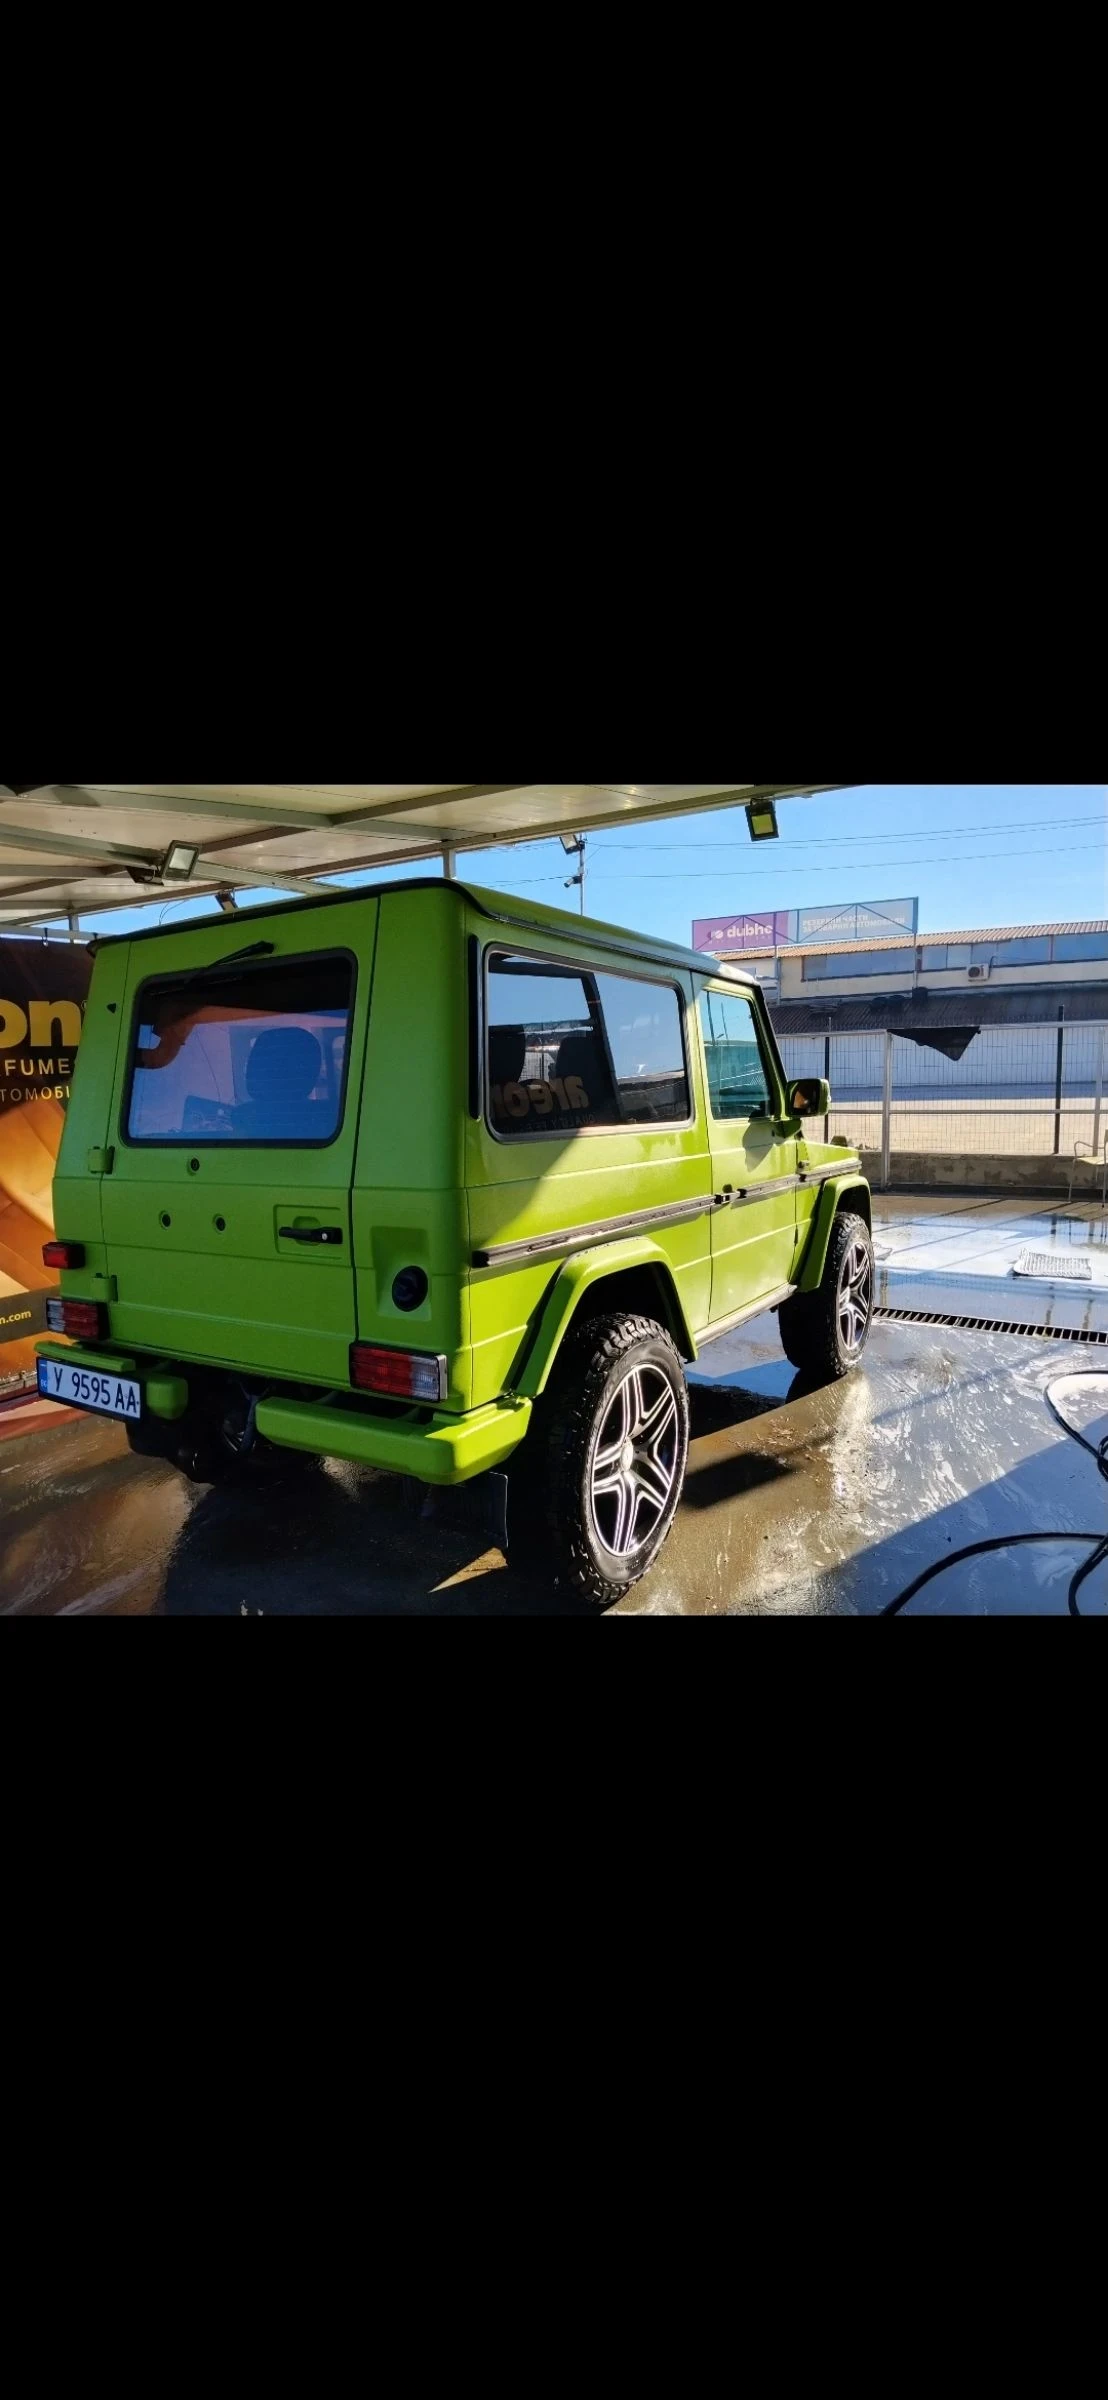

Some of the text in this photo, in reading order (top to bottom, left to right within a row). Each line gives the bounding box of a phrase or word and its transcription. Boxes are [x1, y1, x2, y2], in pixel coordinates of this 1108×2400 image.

[726, 923, 773, 938] dubhe
[0, 1057, 71, 1077] FUME
[71, 1371, 111, 1406] 9595
[114, 1383, 137, 1413] AA
